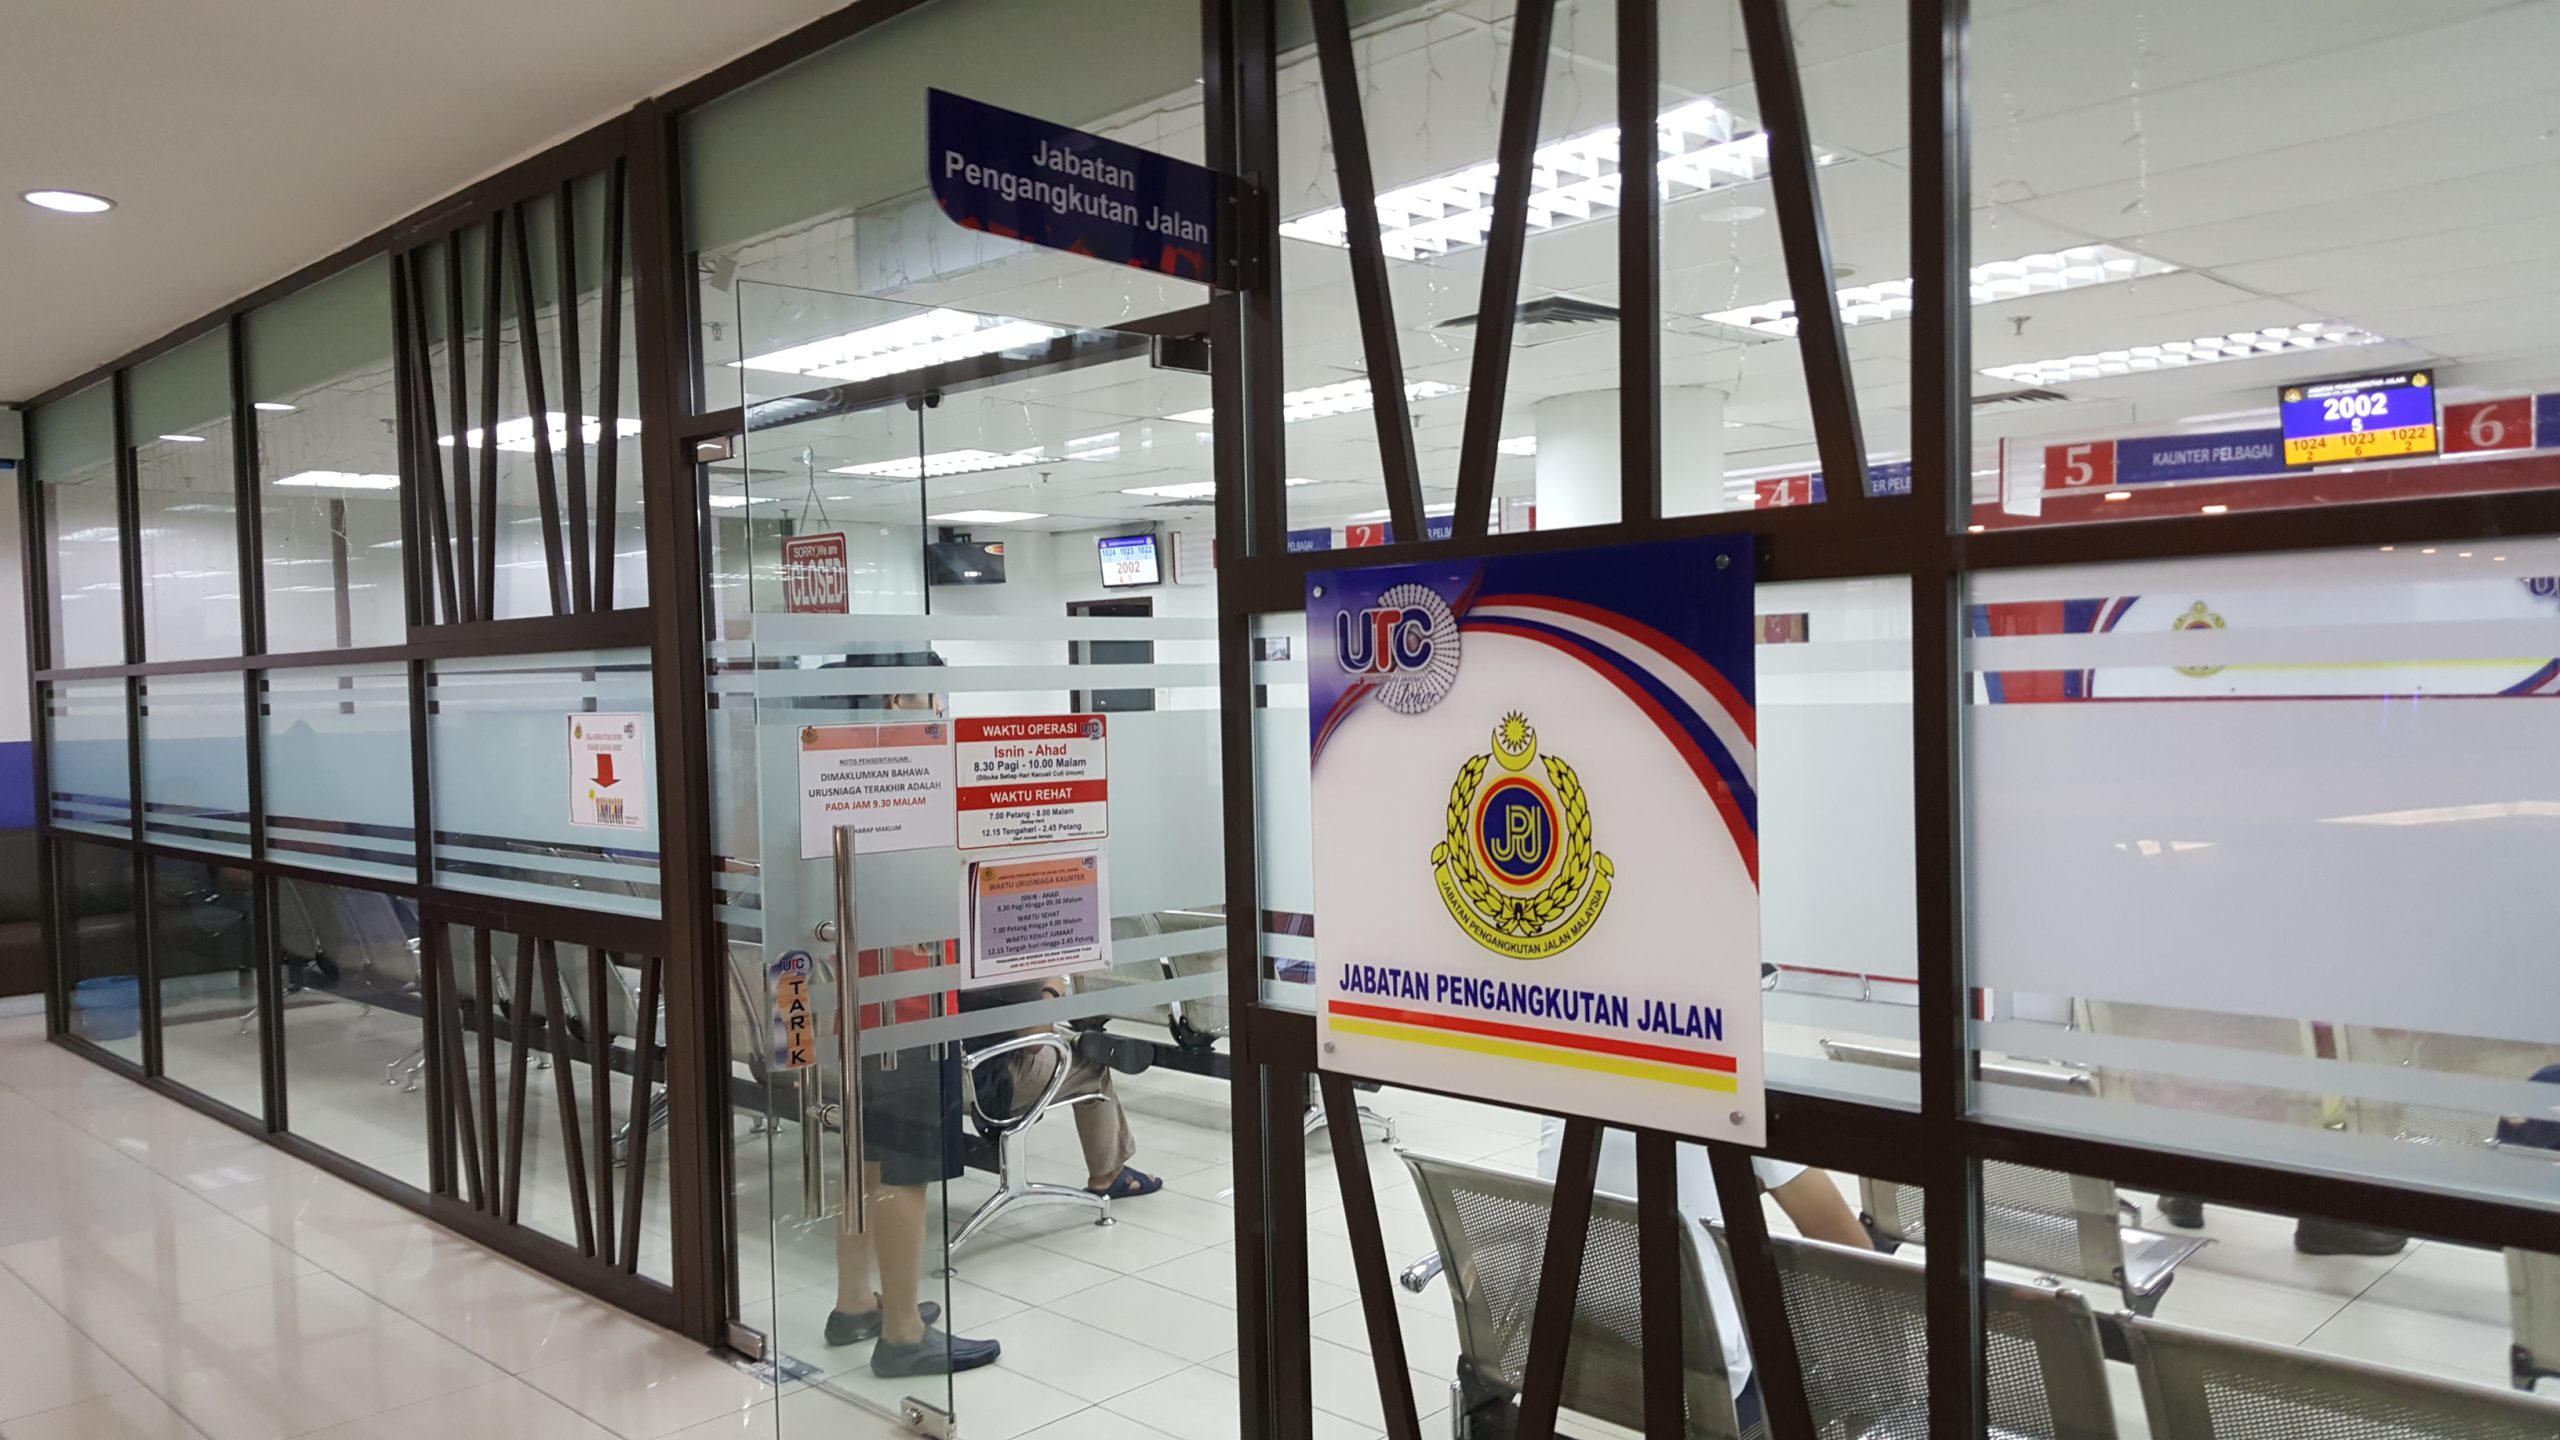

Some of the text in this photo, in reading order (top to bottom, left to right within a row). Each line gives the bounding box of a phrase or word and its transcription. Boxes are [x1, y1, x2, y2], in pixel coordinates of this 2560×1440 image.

[1032, 140, 1135, 191] Jabatan
[945, 150, 1209, 244] Pengangkutan Jalan
[2323, 392, 2389, 421] 2002
[2469, 404, 2504, 447] 6
[2293, 427, 2426, 451] 1024 1023 1022
[2306, 441, 2412, 461] 2 6 2
[2064, 443, 2274, 486] 5 KAUNTER PELBAGAI
[1769, 478, 1794, 506] 4
[1356, 526, 1371, 547] 2
[1120, 547, 1134, 555] 1023
[1137, 546, 1153, 554] 1022
[1117, 560, 1141, 574] 2002
[791, 558, 844, 606] CLOSED
[1336, 605, 1435, 674] UTC
[982, 722, 1077, 737] WAKTU OPERASI
[994, 745, 1025, 759] Isnin
[1035, 743, 1067, 757] Ahad
[839, 758, 858, 766] NOTIS
[973, 761, 994, 772] 8.30
[997, 760, 1019, 773] Pagi
[1028, 758, 1053, 769] 10.00
[1055, 757, 1087, 768] Malam
[820, 768, 929, 782] DIMAKLUMKAN BAHAWA
[808, 781, 942, 798] URUSNIAGA TERAKHIR ADALAH
[990, 787, 1072, 804] WAKTU REHAT
[825, 797, 927, 812] PADA JAM 9.30 MALAM
[989, 812, 1005, 820] 7.00
[1005, 810, 1031, 820] Petang
[1052, 808, 1074, 816] Malam
[875, 824, 902, 833] MAKLUM
[982, 829, 1001, 838] 12.15
[1002, 826, 1037, 836] Tengahari
[1042, 824, 1057, 833] 2.45
[1058, 822, 1082, 833] Petang
[1490, 804, 1541, 864] JPJ
[989, 874, 1085, 892] WAKTU URUSNIAGA KAUNTER
[1042, 891, 1060, 900] AHAD
[1017, 913, 1040, 922] WAKTU
[1440, 879, 1604, 955] JABATAN PENGANGKUTAN JALAN MALAYSIA
[1005, 935, 1028, 944] WAKTU
[781, 957, 805, 971] UTC
[1339, 963, 1723, 1041] JABATAN PENGANGKUTAN JALAN
[789, 980, 806, 1065] TARIK
